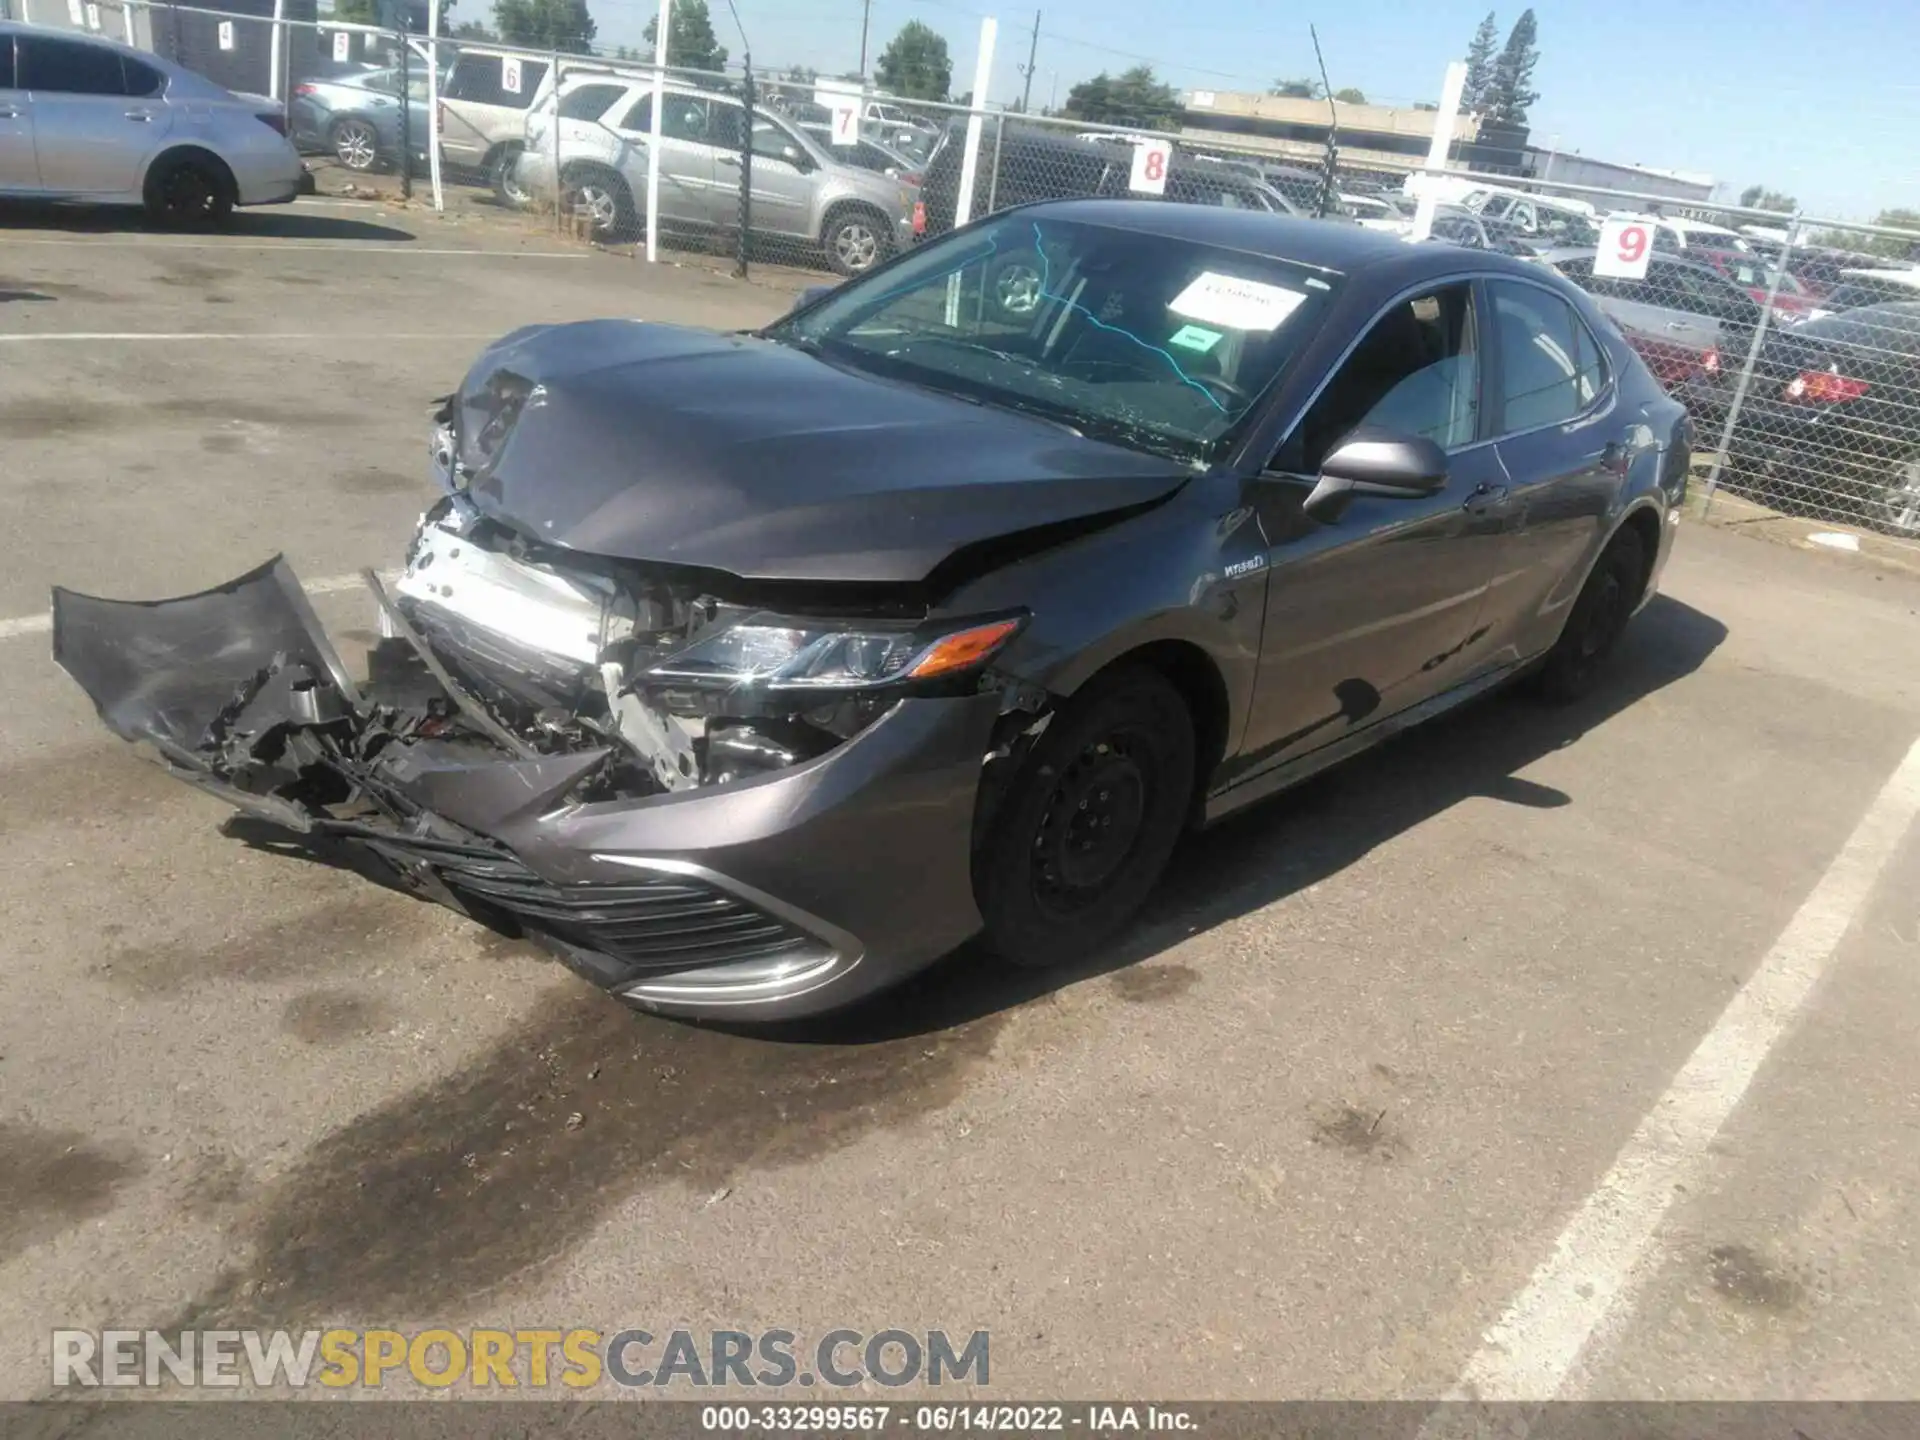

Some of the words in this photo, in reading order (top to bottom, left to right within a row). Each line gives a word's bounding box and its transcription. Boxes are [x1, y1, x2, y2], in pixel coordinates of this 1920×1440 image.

[507, 67, 517, 89] 6
[838, 108, 853, 134] 7
[1144, 151, 1164, 180] 8
[1617, 226, 1646, 262] 9
